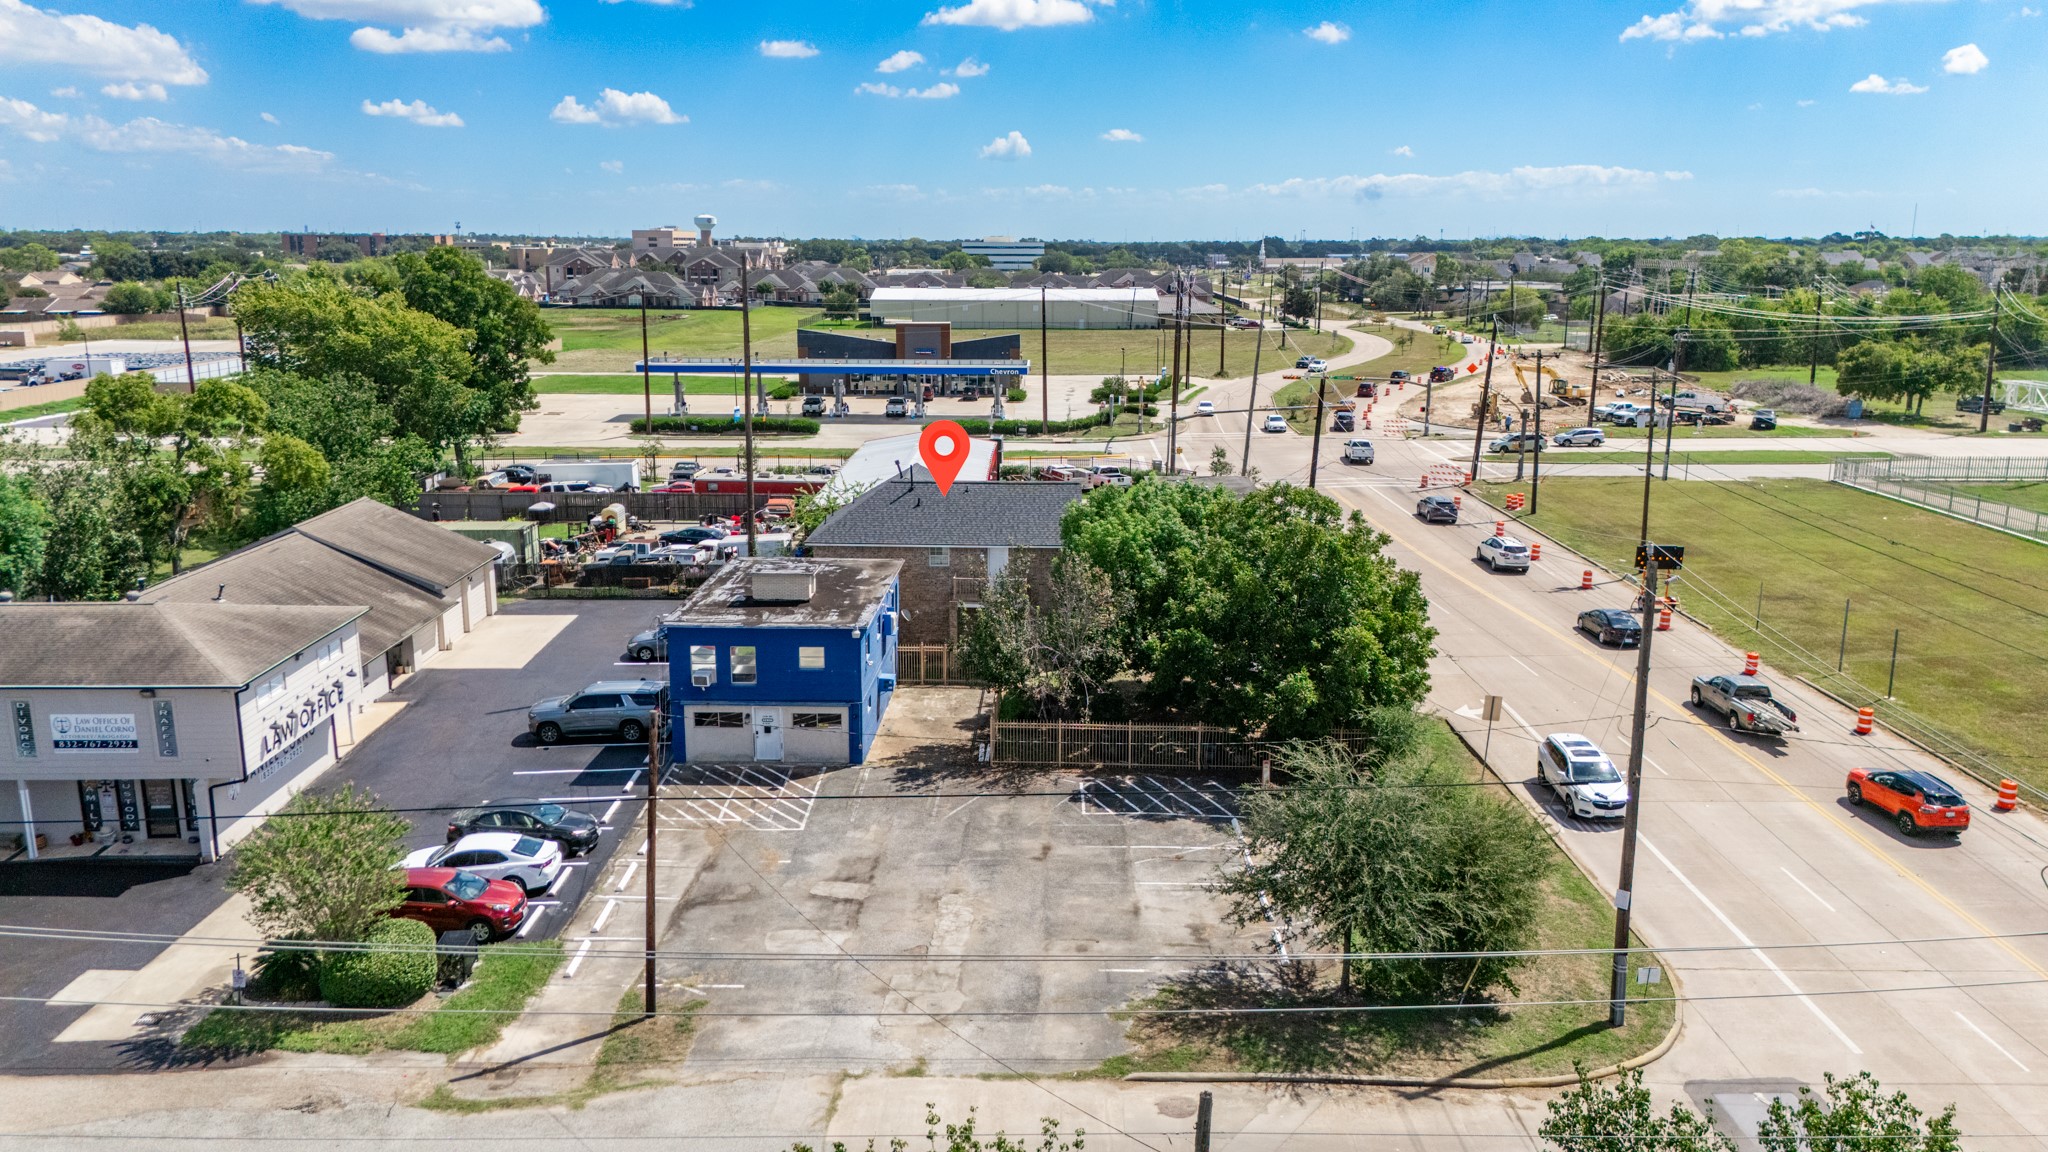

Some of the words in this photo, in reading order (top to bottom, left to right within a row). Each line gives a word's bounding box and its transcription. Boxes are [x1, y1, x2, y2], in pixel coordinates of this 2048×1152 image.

[16, 702, 32, 756] DIVORCE
[74, 725, 103, 733] DANIEL
[104, 725, 135, 733] CORNO
[75, 717, 90, 725] LAW
[92, 717, 118, 725] OFFICE
[159, 702, 173, 756] TRAFFIC
[264, 717, 294, 754] LAW
[300, 687, 344, 729] OFFICE
[58, 740, 133, 748] 832-767-2922
[85, 784, 99, 828] AMILY
[122, 783, 136, 828] USTODY
